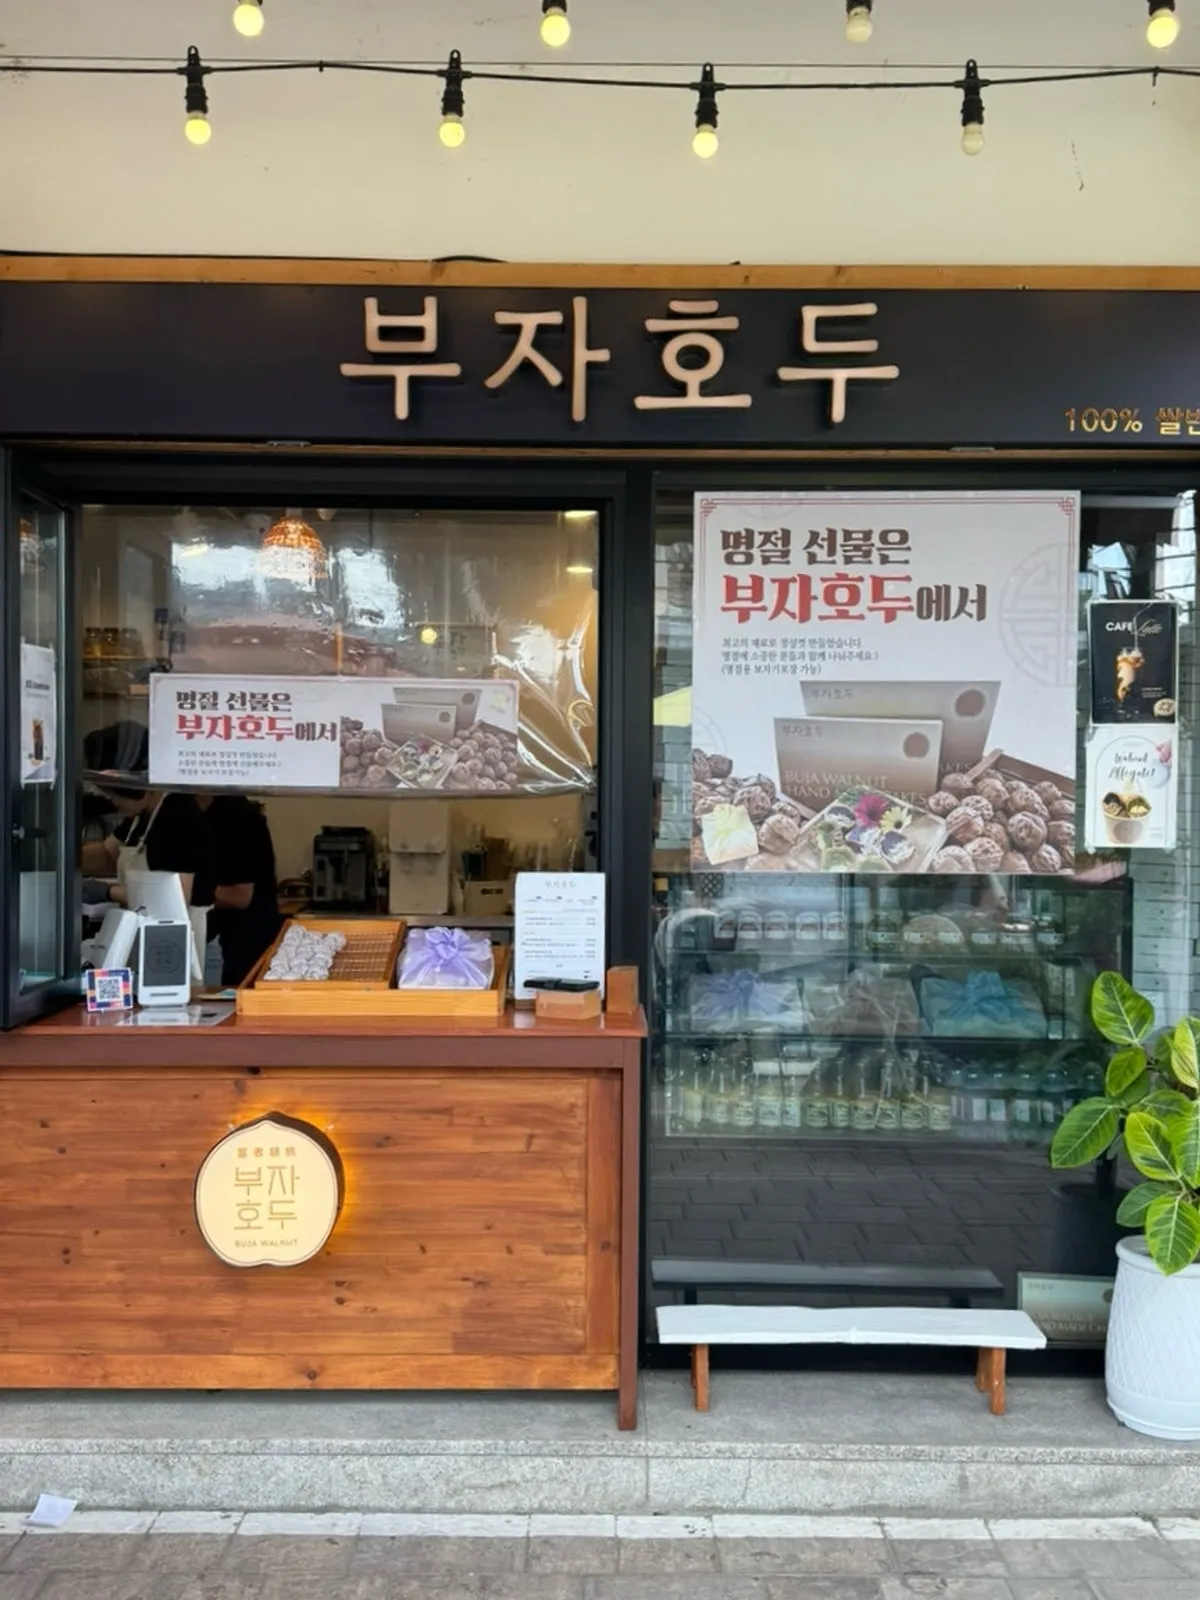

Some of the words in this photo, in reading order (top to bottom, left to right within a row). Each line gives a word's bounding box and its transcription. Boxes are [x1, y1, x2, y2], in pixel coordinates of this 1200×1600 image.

[340, 296, 900, 423] 부자호두
[1065, 407, 1143, 433] 100%
[720, 527, 792, 567] 명절
[802, 527, 912, 566] 선물은
[720, 572, 988, 625] 부자호두에서
[1105, 621, 1133, 632] CAFE
[176, 690, 219, 711] 명절
[226, 690, 292, 712] 선물은
[176, 714, 338, 742] 부자호두에서
[786, 785, 831, 799] HAND
[233, 1164, 301, 1197] 부자
[233, 1199, 298, 1230] 호두
[234, 1239, 257, 1248] BUJA
[260, 1238, 298, 1248] WALNUT
